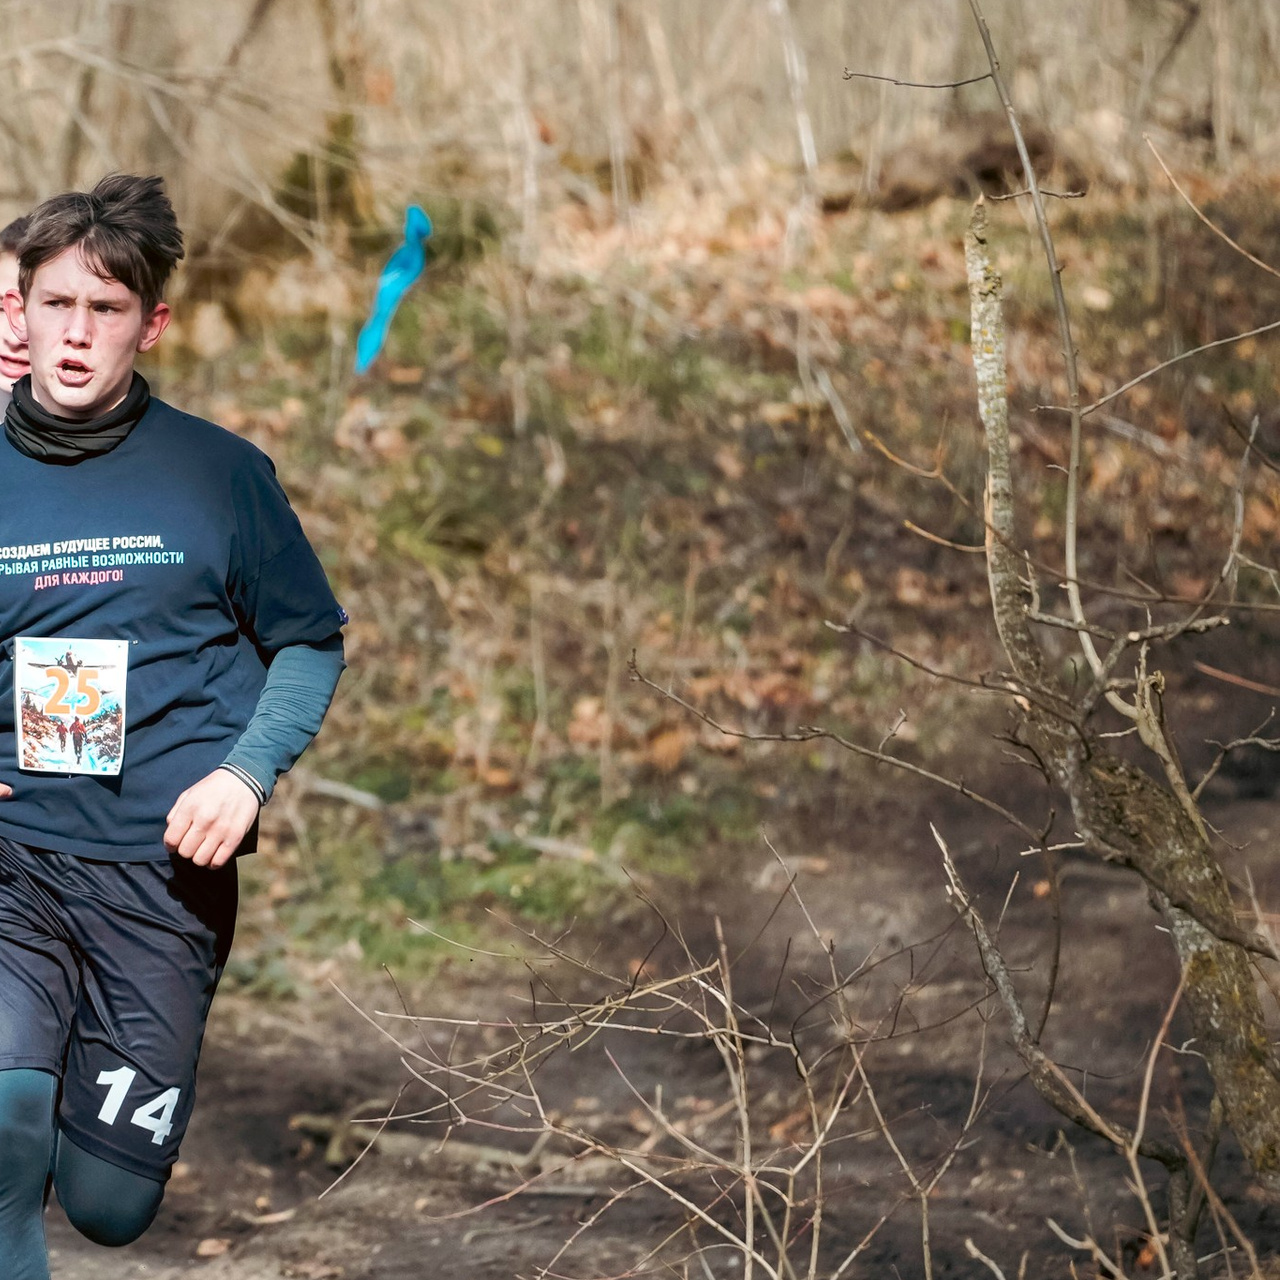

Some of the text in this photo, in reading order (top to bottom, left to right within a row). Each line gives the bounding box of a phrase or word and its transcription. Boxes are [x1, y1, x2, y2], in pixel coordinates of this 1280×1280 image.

[53, 537, 110, 554] БУДУЩЕЕ
[112, 535, 164, 549] РОССИИ,
[41, 555, 89, 572] РАВНЫЕ
[92, 551, 184, 567] ВОЗМОЖНОСТИ
[34, 569, 123, 590] ДЛЯ КАЖДОГО!
[44, 667, 100, 715] 25
[96, 1065, 181, 1146] 14
